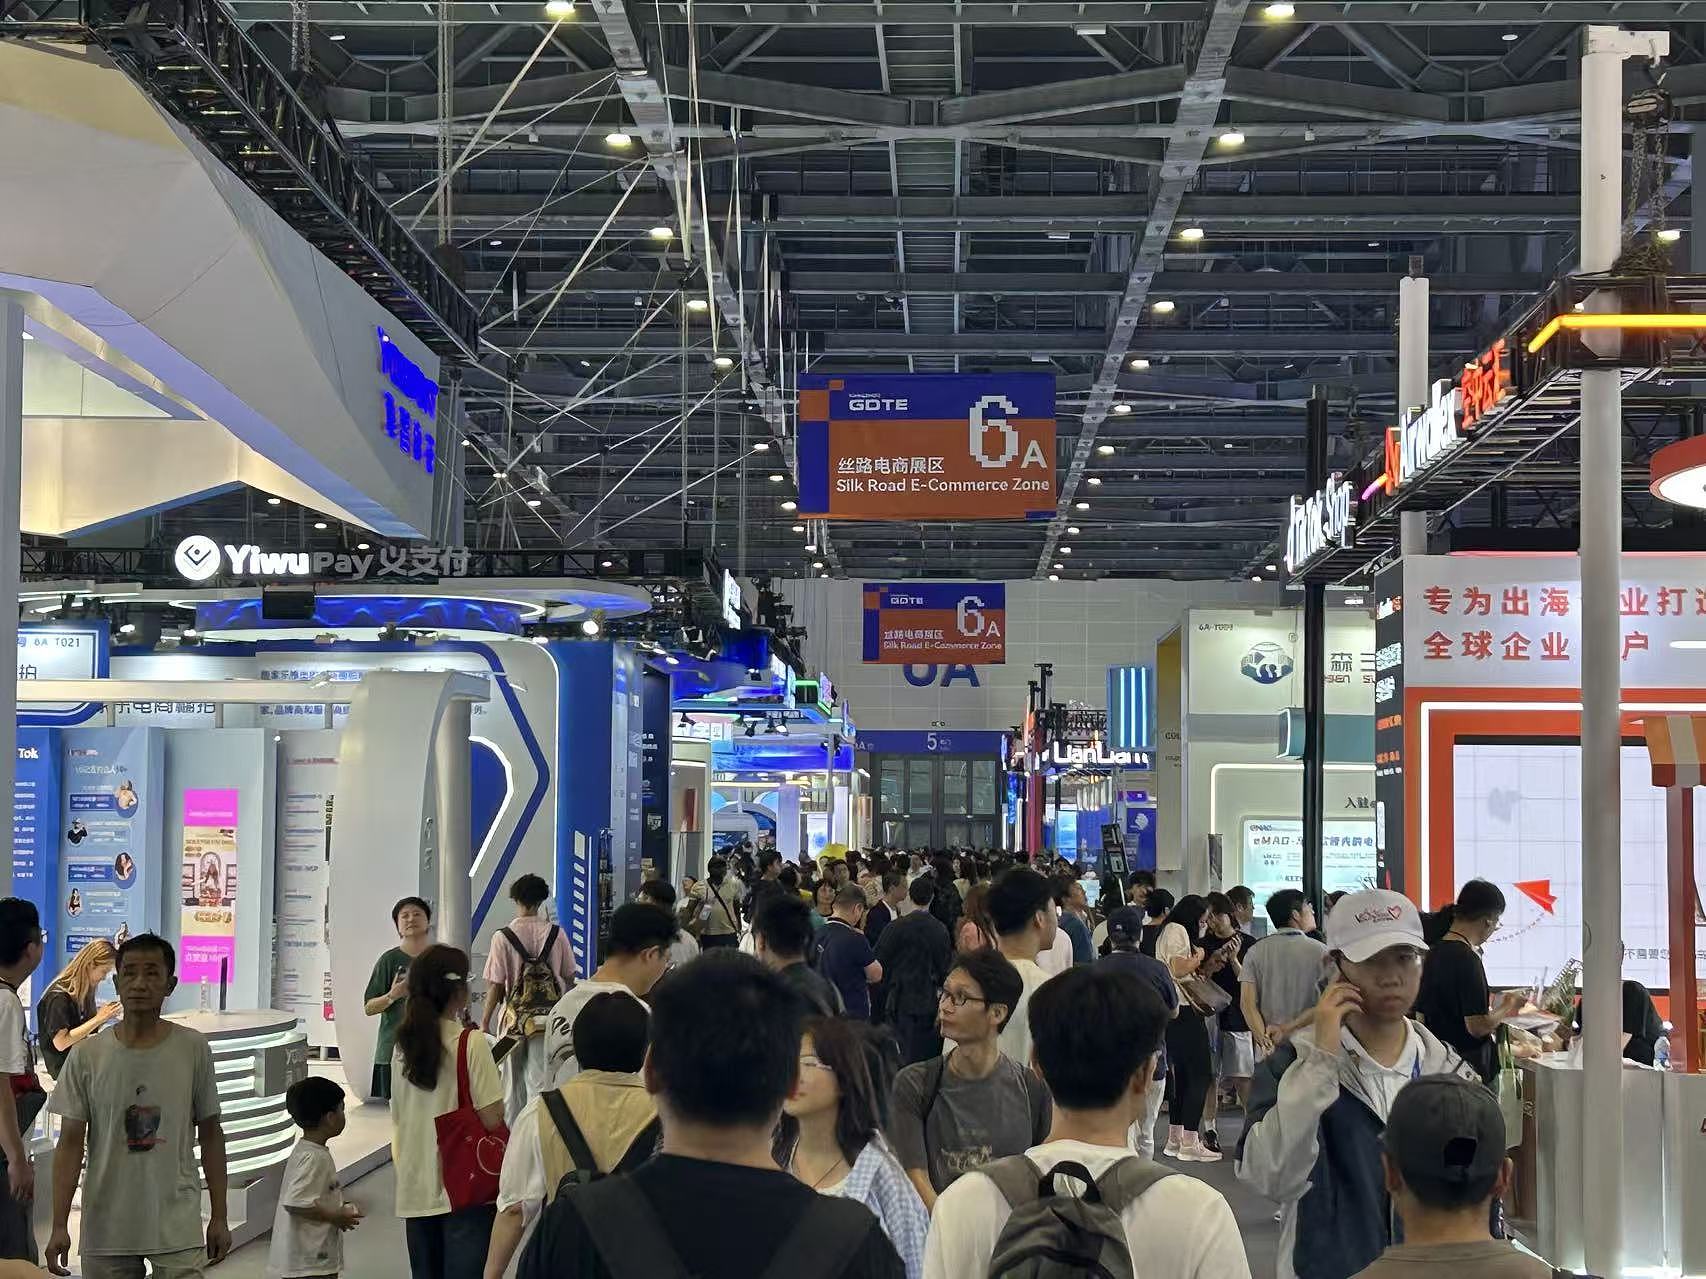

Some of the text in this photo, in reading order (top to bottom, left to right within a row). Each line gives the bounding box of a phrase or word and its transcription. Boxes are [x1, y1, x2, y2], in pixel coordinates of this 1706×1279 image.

[849, 398, 908, 411] GDTE
[837, 456, 945, 475] 丝路电商展区
[836, 478, 1050, 492] Silk Road E-Commerce Zone
[376, 545, 471, 577] 义支付
[1423, 585, 1706, 617] 专为出海业打
[55, 638, 80, 647] T021
[1423, 631, 1649, 661] 全球企业户
